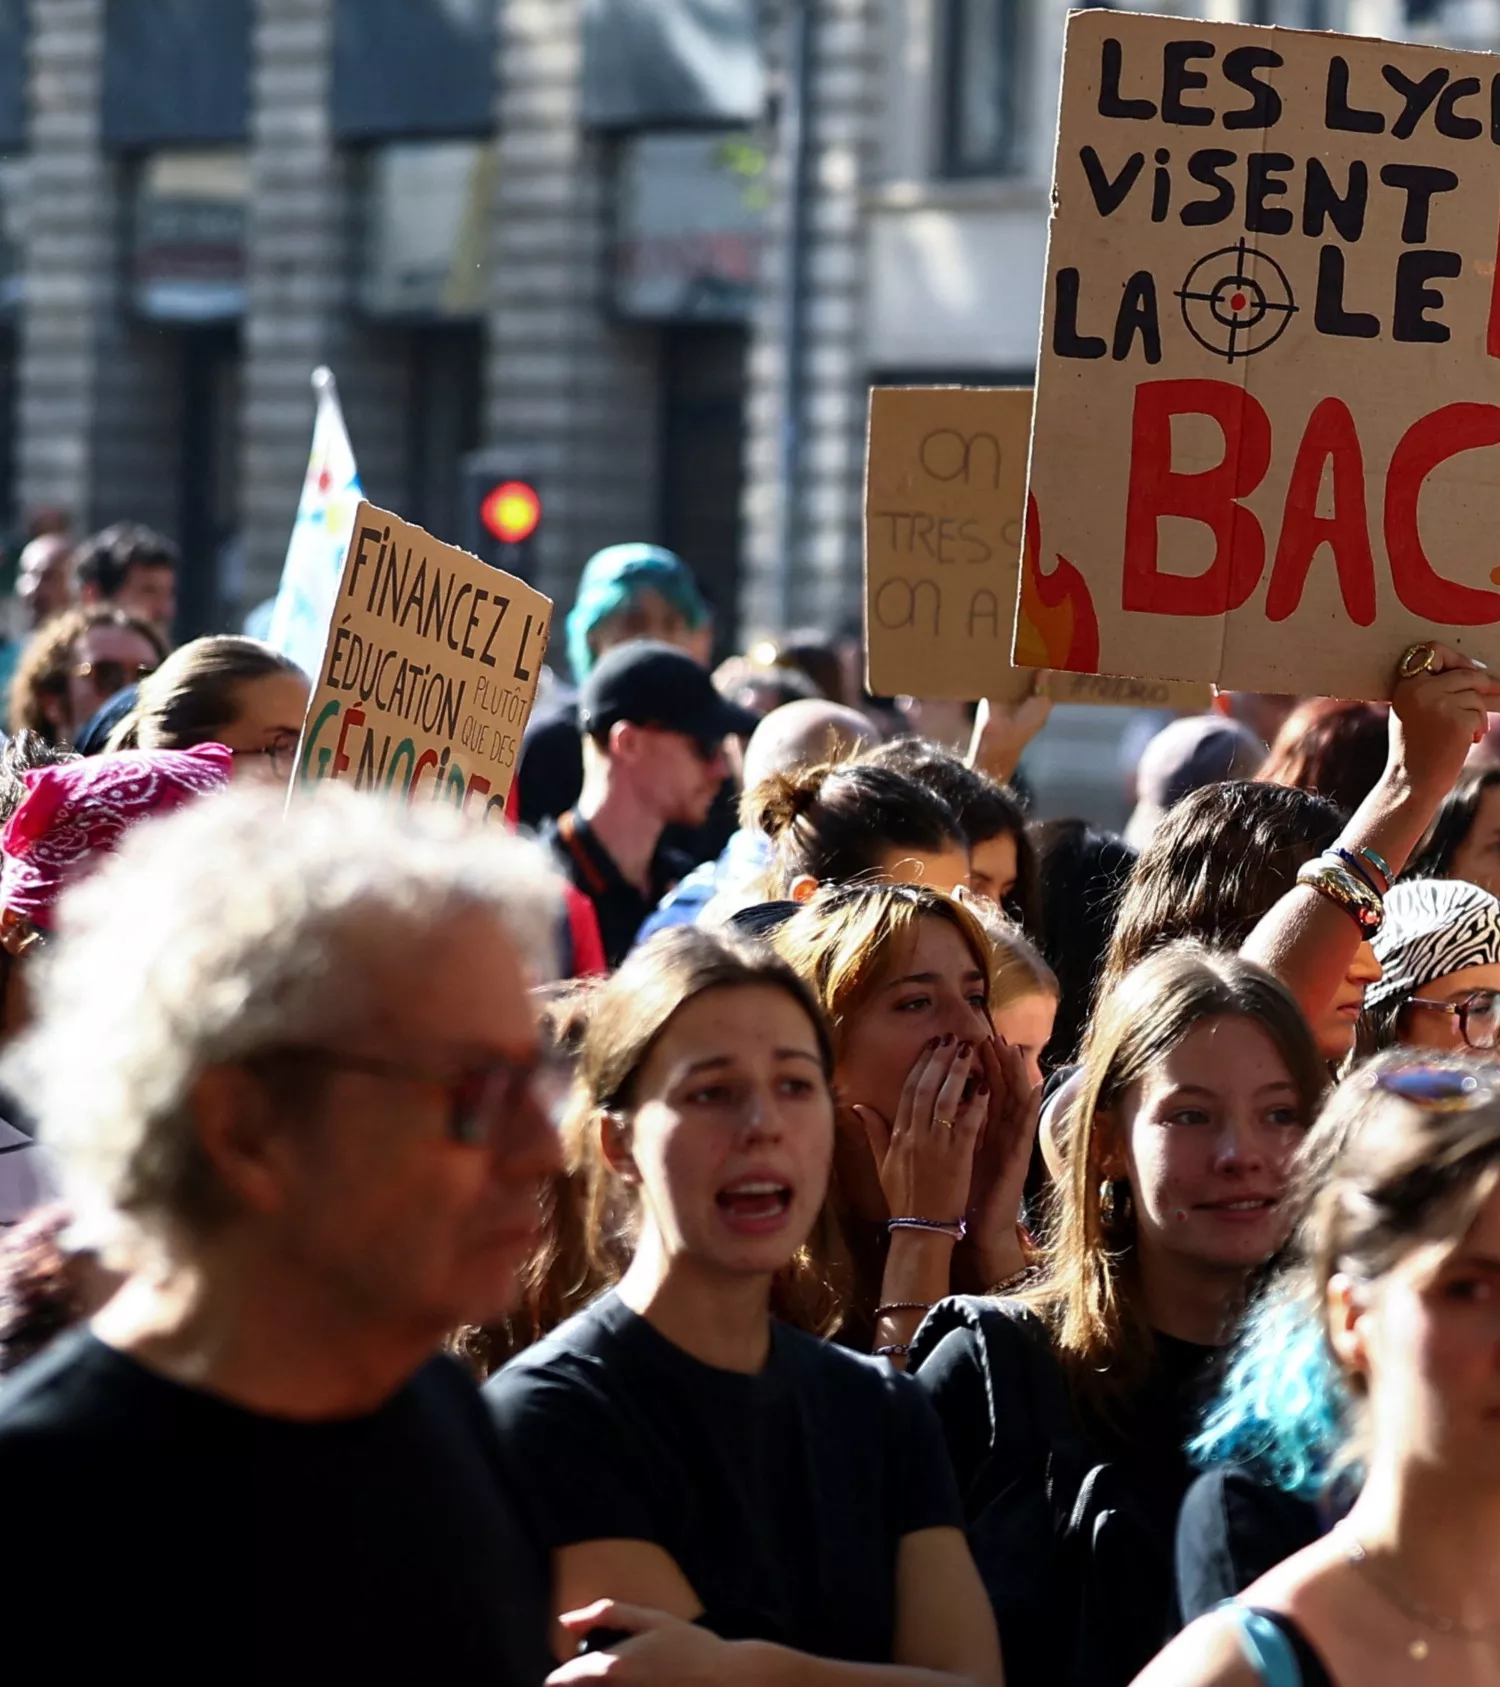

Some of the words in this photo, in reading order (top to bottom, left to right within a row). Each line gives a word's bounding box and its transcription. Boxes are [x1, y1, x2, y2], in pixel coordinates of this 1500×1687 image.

[1098, 38, 1282, 130] LES
[1052, 267, 1162, 364] LA
[1314, 244, 1462, 343] LE
[875, 511, 992, 564] TRES
[513, 614, 544, 682] L'
[472, 675, 528, 728] PLUTÔT
[461, 715, 489, 756] QUE
[489, 727, 516, 768] DES
